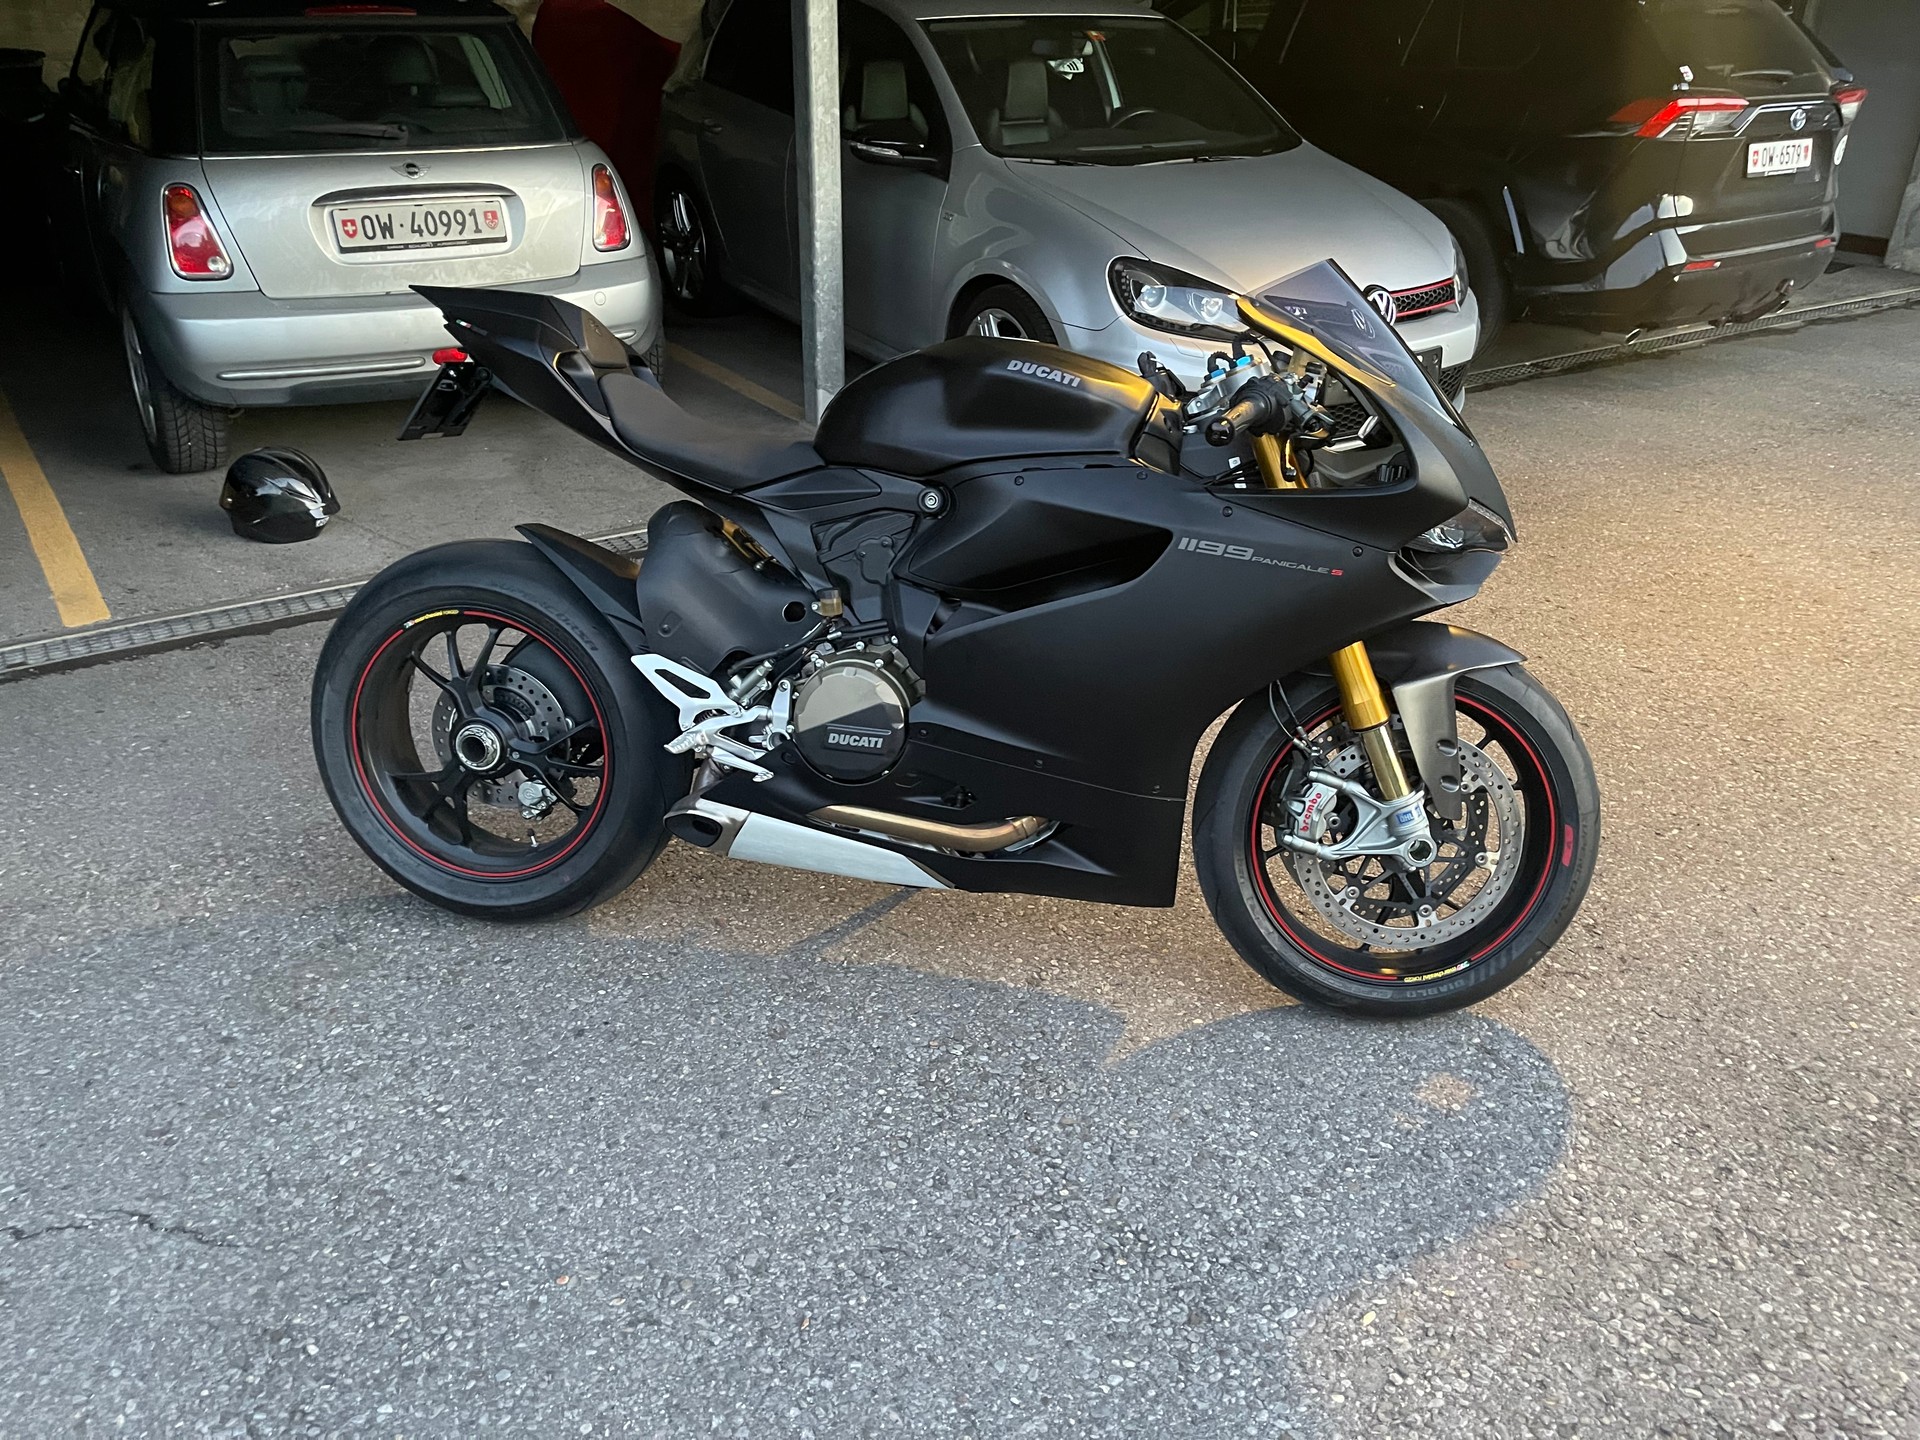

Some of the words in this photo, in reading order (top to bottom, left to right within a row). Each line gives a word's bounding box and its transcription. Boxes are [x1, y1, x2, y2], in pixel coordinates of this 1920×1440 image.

[1007, 360, 1081, 387] DUCATI
[1178, 537, 1254, 561] 1199
[1251, 556, 1330, 574] PANIGALE
[828, 733, 883, 749] DUCATI
[1300, 792, 1322, 832] brembo
